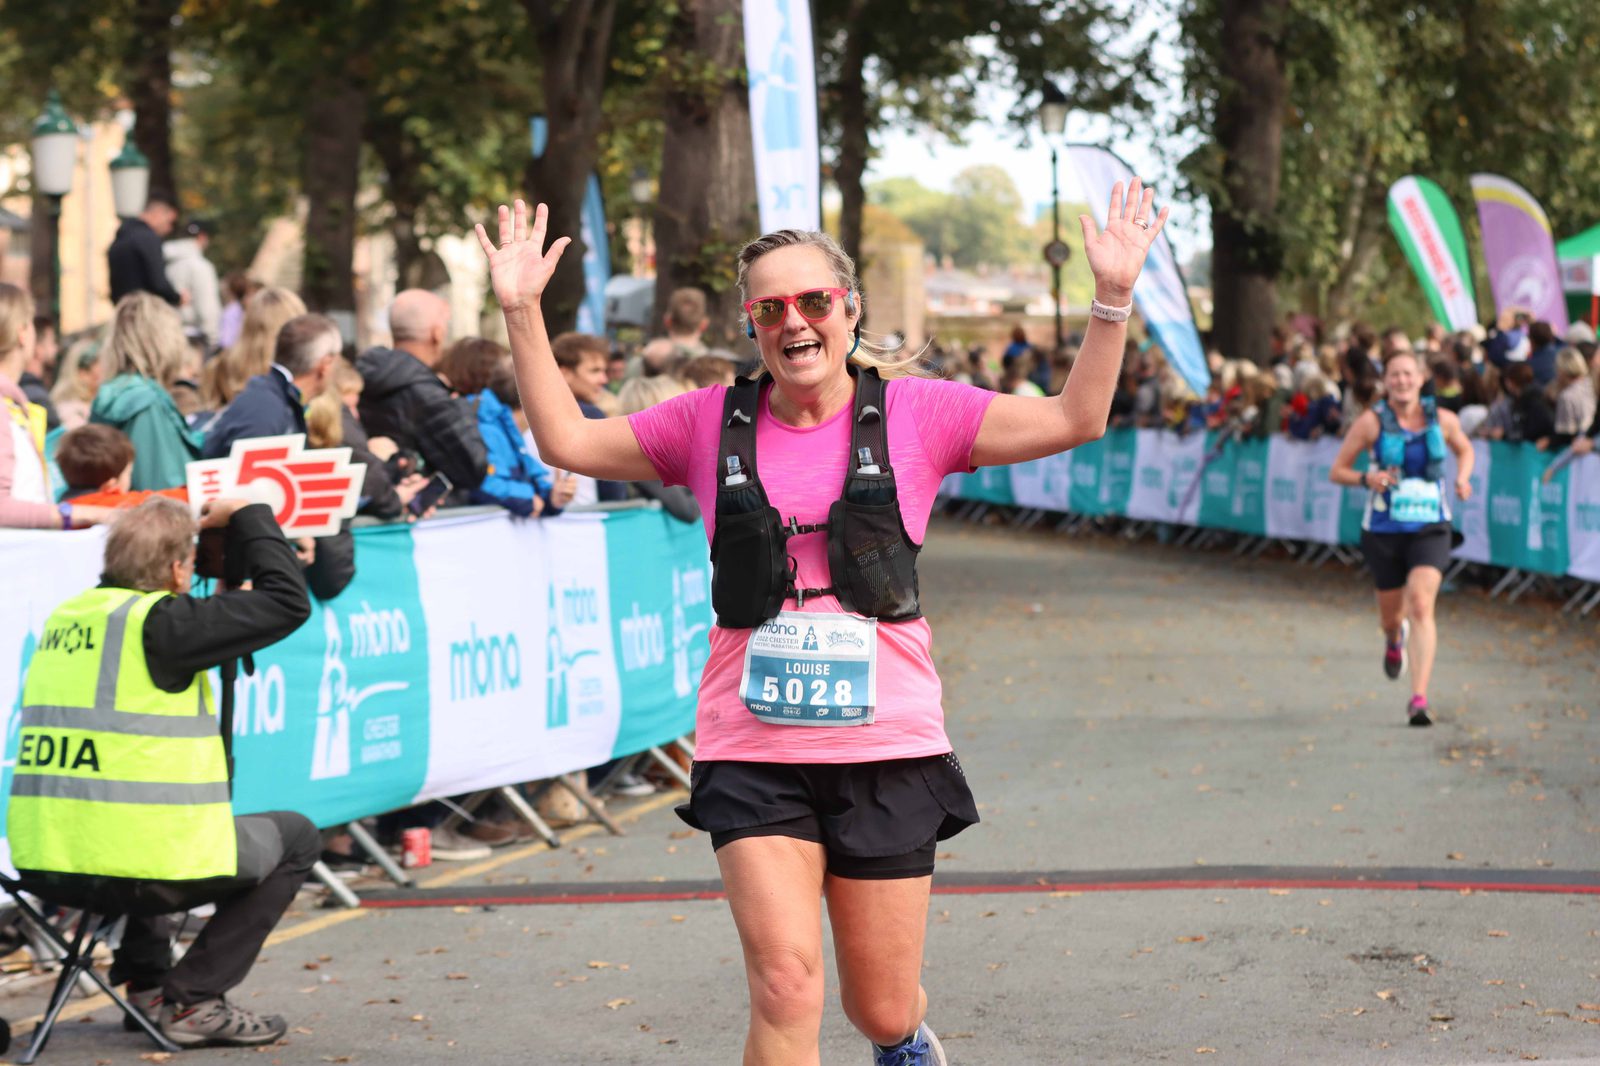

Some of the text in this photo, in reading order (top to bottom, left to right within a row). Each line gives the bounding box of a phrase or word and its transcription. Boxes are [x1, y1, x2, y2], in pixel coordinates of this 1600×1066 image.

[201, 469, 222, 502] HI
[237, 447, 297, 528] 5
[349, 600, 410, 658] mbna
[760, 621, 798, 636] mbna
[769, 637, 799, 645] CHESTER
[449, 621, 521, 702] mbna
[785, 662, 830, 675] LOUISE
[762, 676, 852, 706] 5028
[750, 703, 772, 712] mbna
[19, 734, 101, 772] EDIA
